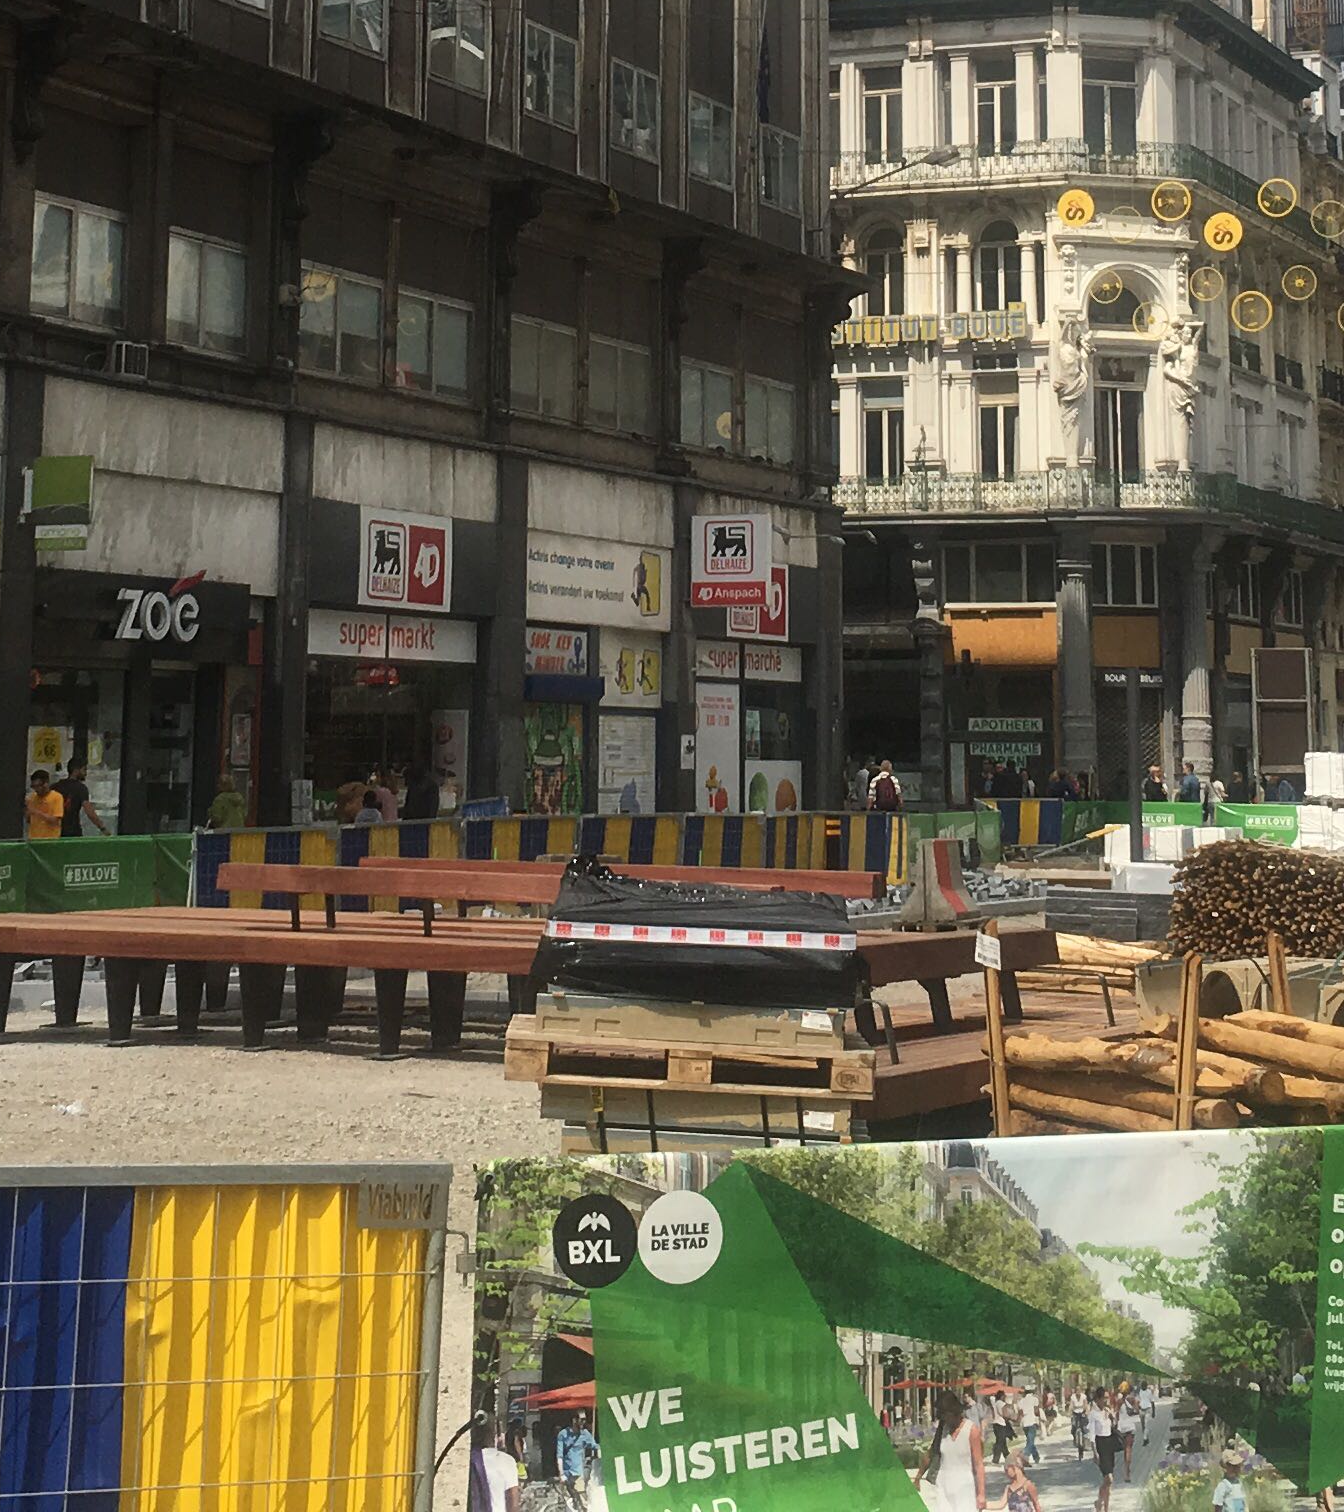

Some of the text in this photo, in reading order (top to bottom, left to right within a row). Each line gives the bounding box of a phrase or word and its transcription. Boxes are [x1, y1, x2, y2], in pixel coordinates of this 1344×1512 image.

[711, 558, 749, 571] DELHAIZE
[714, 587, 762, 602] Anspach
[339, 622, 436, 654] super markt
[744, 648, 782, 673] marché
[971, 719, 1040, 731] APOTHEEK
[971, 743, 1040, 755] PHARMACIE
[64, 866, 118, 884] #BXLOVE
[651, 1223, 710, 1237] LA VILLE
[568, 1239, 621, 1265] BXL
[651, 1237, 708, 1251] DE STAD
[606, 1386, 685, 1433] WE
[614, 1413, 860, 1495] LUISTEREN
